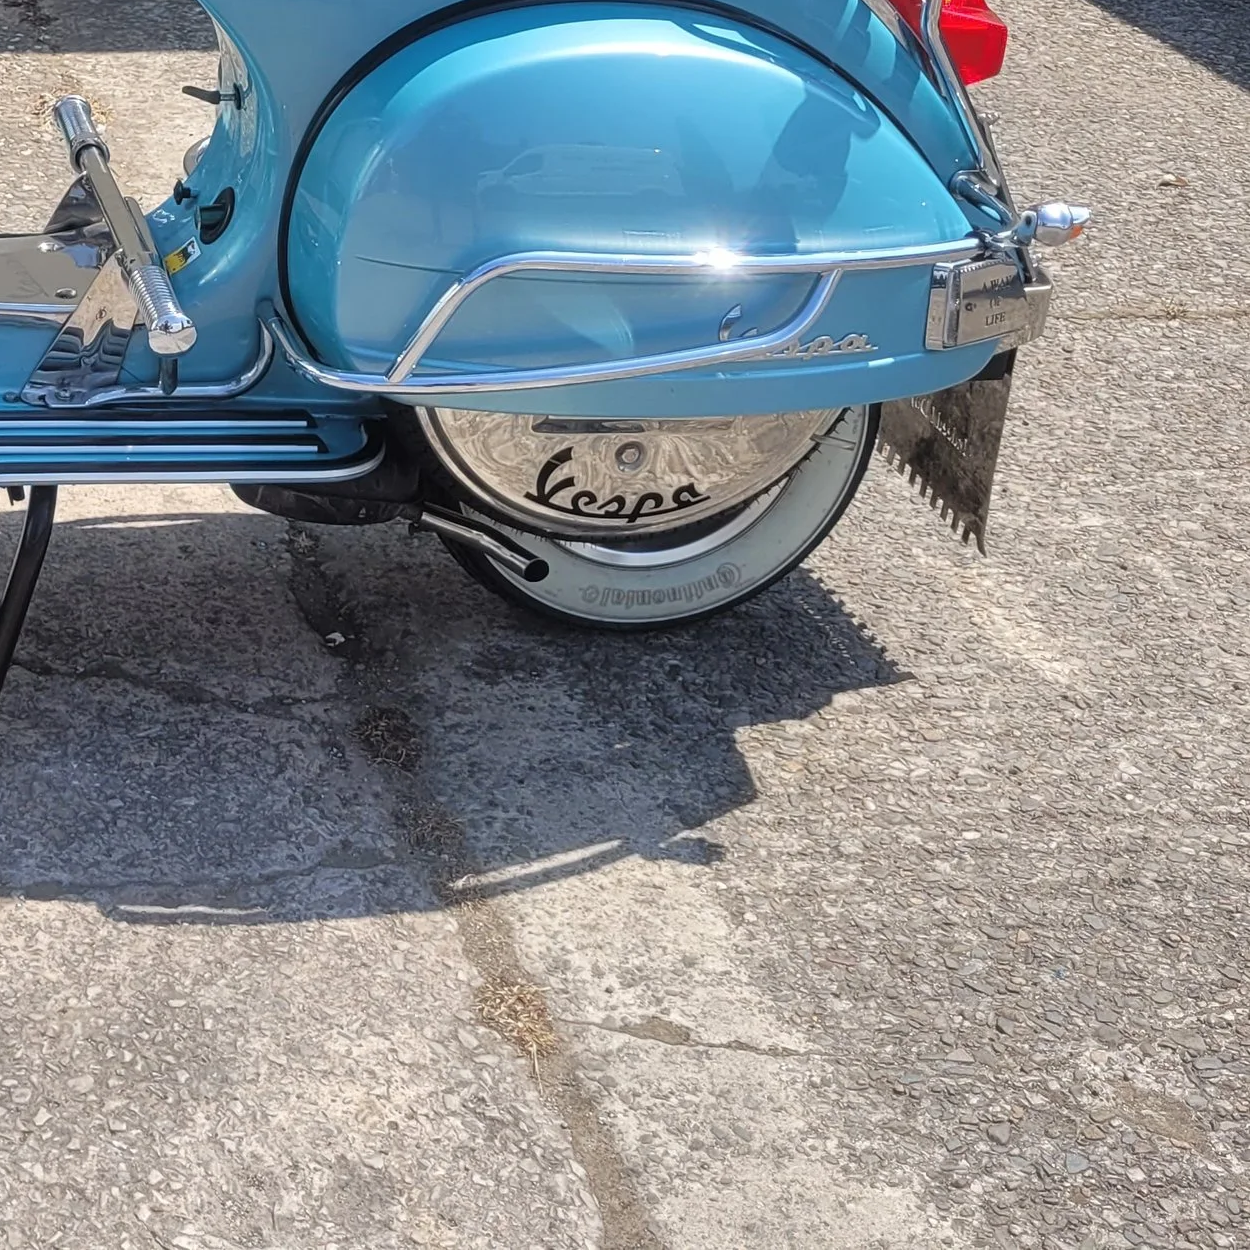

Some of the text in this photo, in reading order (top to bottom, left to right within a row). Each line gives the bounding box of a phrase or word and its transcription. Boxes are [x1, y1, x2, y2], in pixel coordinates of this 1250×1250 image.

[985, 312, 1006, 327] LIFE
[523, 446, 711, 524] Vespa
[599, 561, 742, 610] Continental
